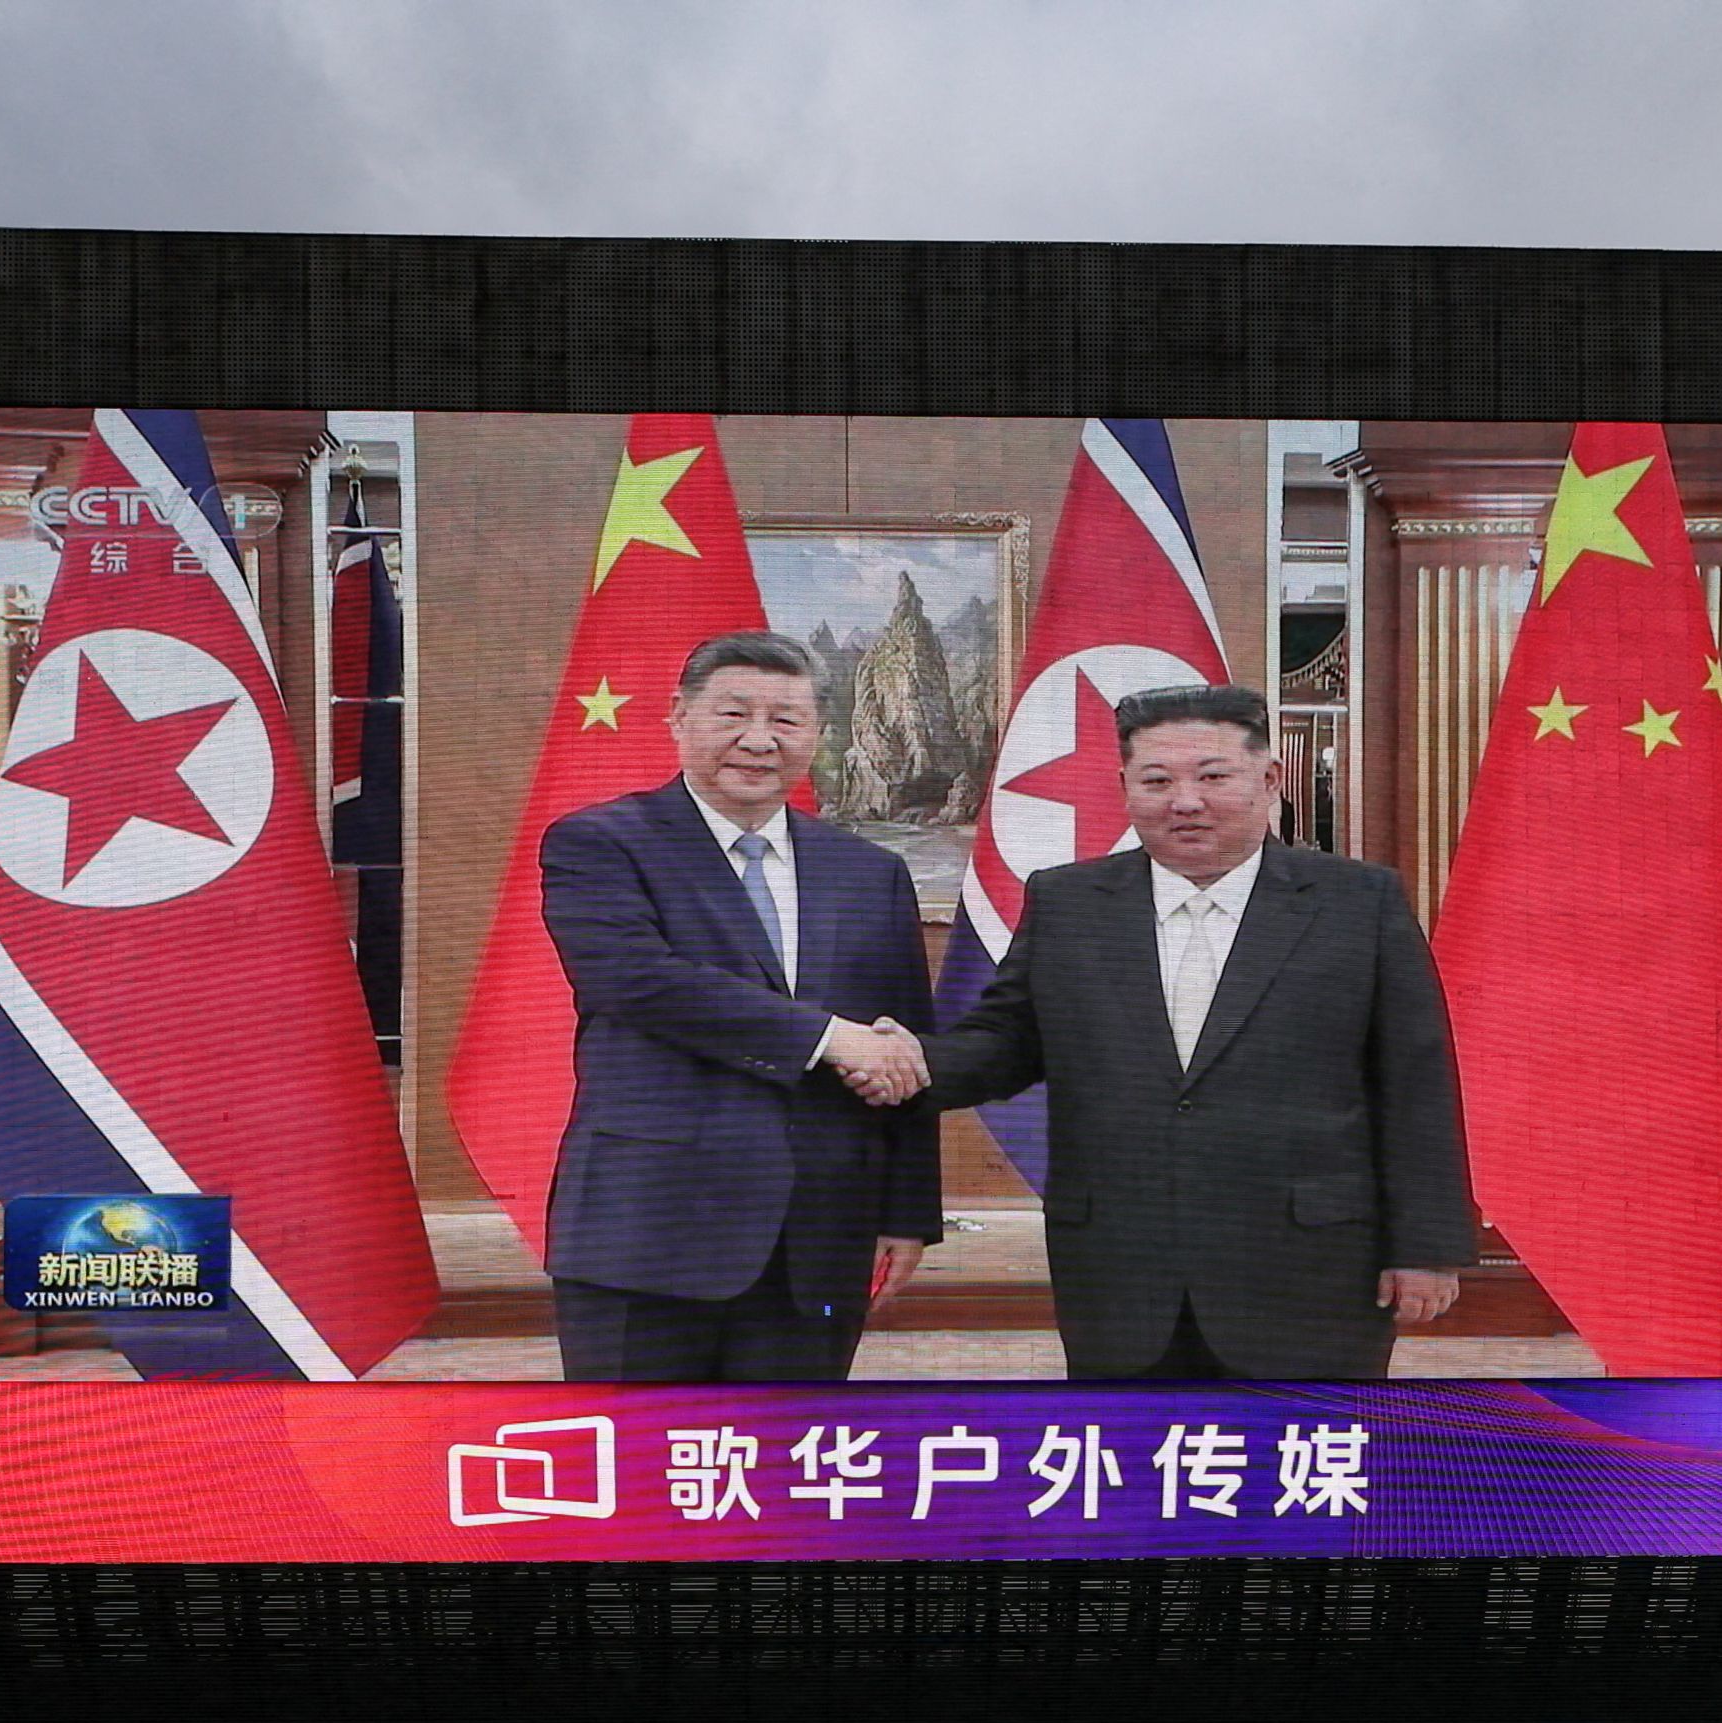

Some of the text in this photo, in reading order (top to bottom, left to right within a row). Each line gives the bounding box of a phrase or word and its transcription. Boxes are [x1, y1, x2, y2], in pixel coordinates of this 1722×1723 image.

[29, 486, 192, 526] CCTV
[90, 541, 209, 574] 综合
[37, 1253, 200, 1288] 新闻联播
[24, 1291, 214, 1307] XINWEN LIANBO
[664, 1423, 1372, 1521] 歌华户外传媒
